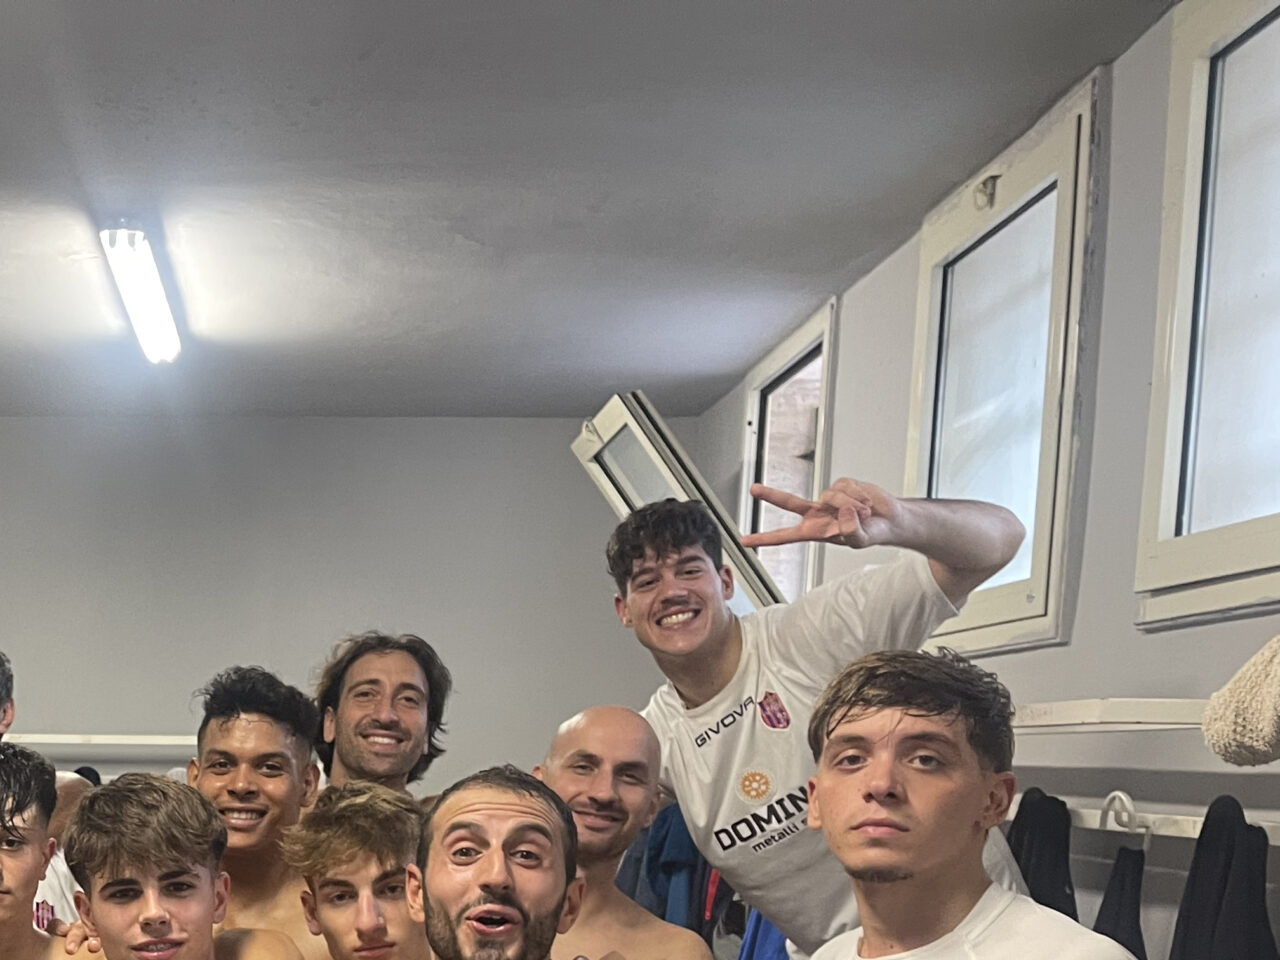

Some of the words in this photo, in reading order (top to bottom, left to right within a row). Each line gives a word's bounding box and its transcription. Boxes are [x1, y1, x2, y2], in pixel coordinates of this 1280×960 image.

[695, 696, 755, 748] GIVOVA
[713, 786, 809, 851] DOMIN
[752, 822, 800, 852] metalli
